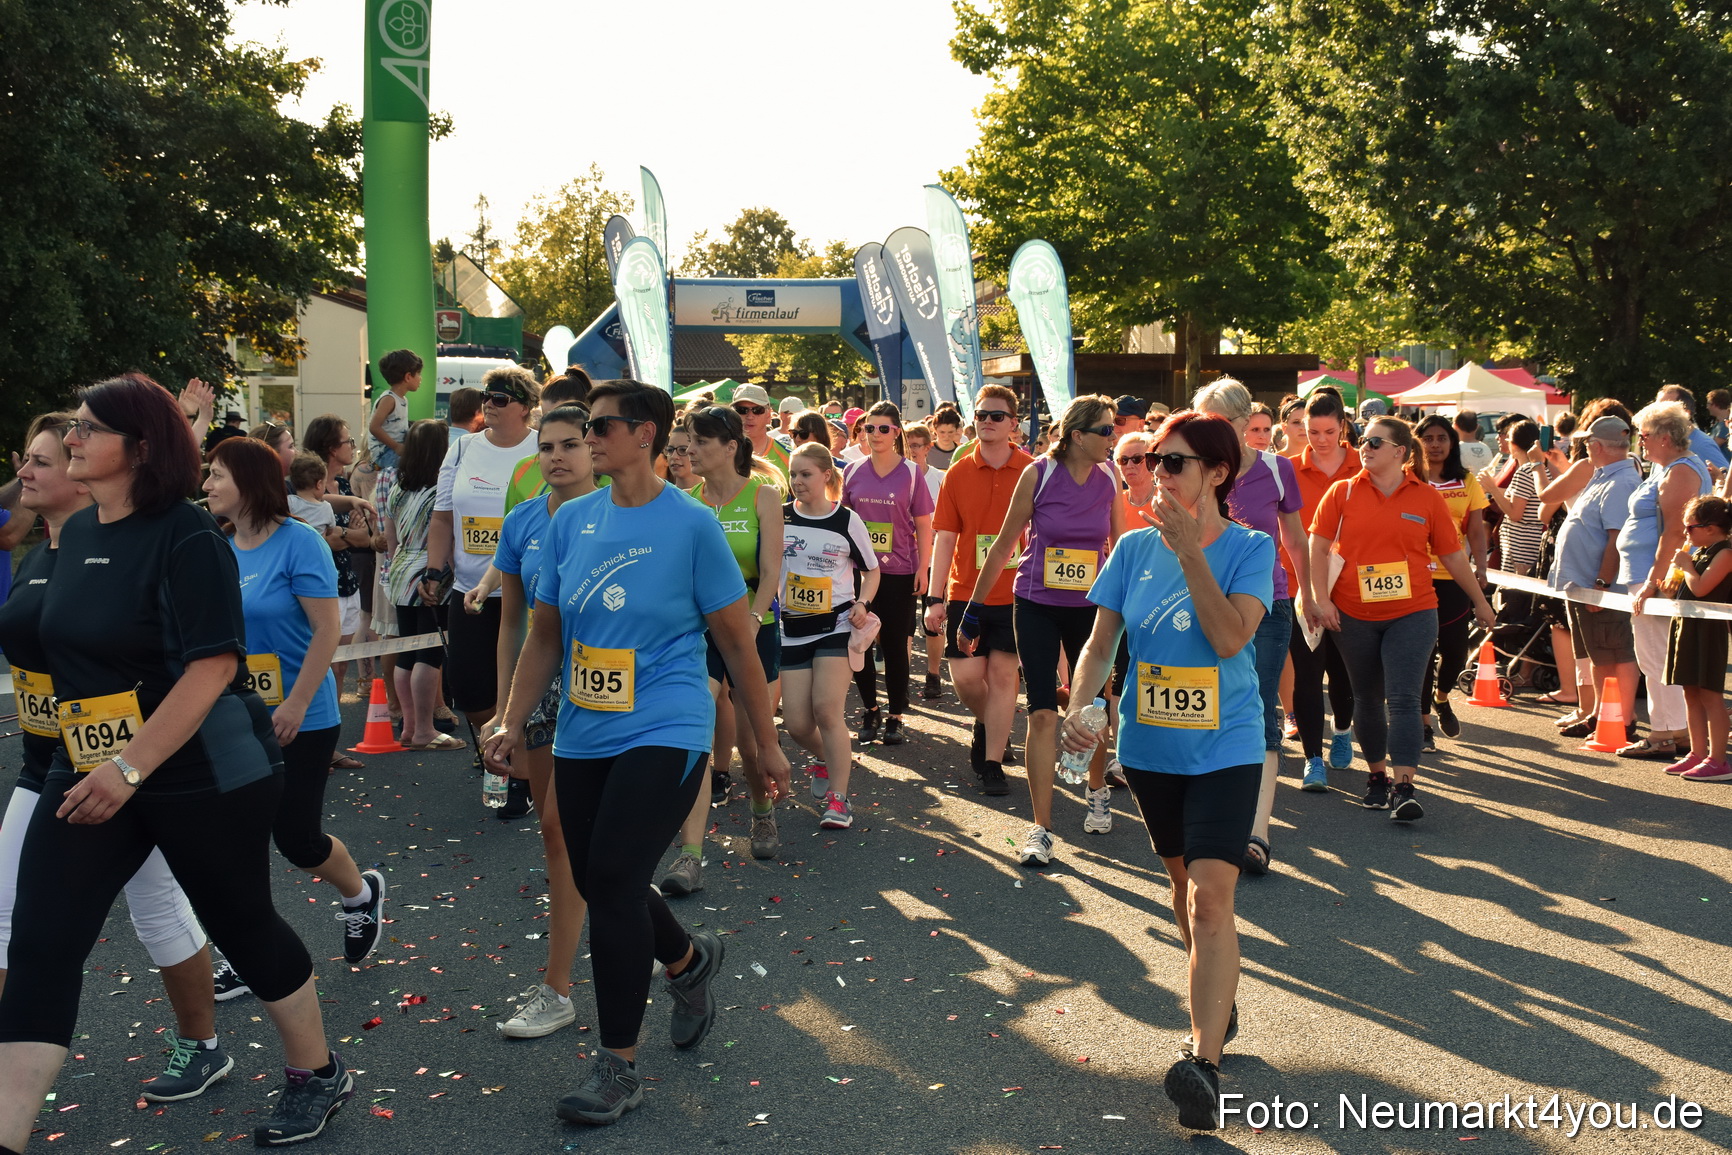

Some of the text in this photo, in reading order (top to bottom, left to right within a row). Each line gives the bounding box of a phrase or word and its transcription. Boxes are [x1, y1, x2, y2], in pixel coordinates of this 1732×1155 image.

[736, 307, 800, 319] firmenlauf
[1443, 490, 1468, 498] BÖGL
[466, 530, 500, 544] 1824
[869, 532, 887, 544] 96
[244, 572, 258, 582] Bau
[567, 546, 653, 606] Team Schick Bau
[1055, 562, 1085, 579] 466
[1364, 575, 1404, 592] 1483
[790, 586, 824, 603] 1481
[1140, 606, 1161, 629] Team
[574, 664, 622, 693] 1195
[577, 689, 593, 698] Lehner
[1145, 686, 1207, 711] 1193
[1147, 708, 1179, 717] Nestmeyer
[72, 719, 134, 752] 1694
[79, 751, 101, 760] Segerer
